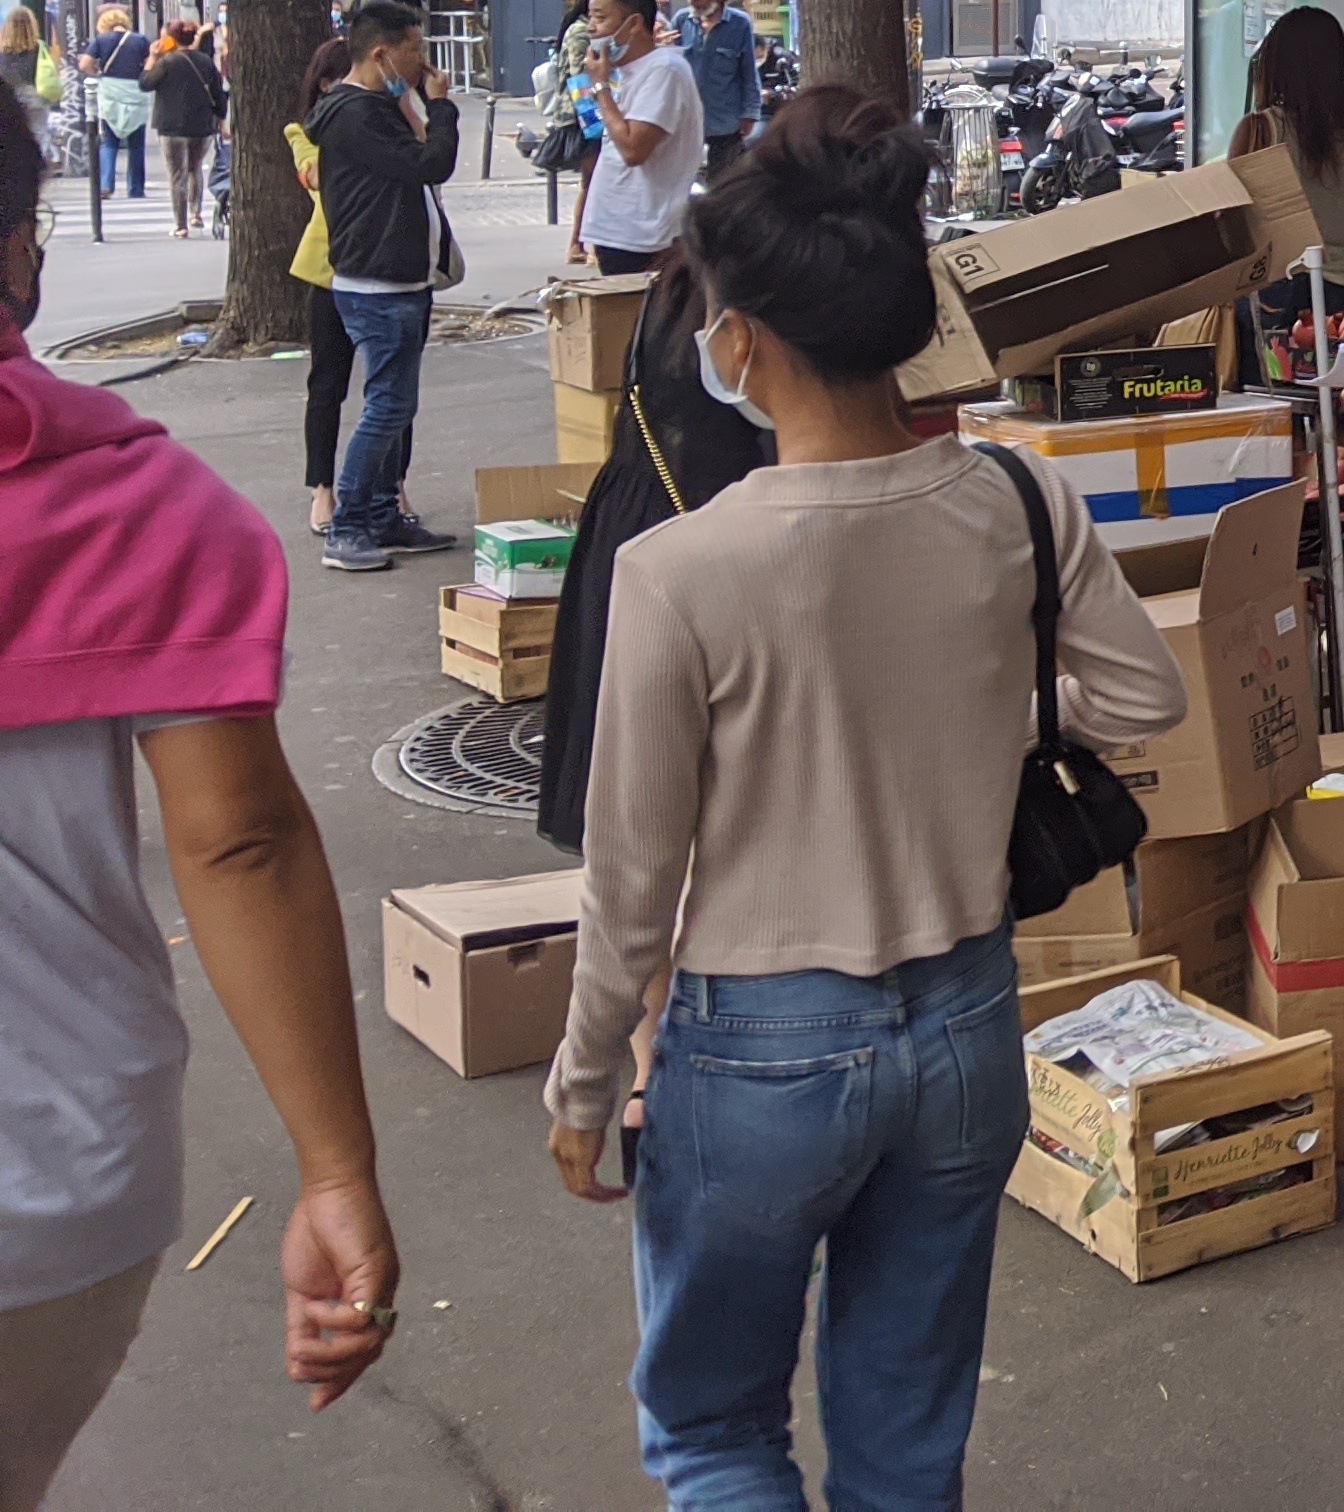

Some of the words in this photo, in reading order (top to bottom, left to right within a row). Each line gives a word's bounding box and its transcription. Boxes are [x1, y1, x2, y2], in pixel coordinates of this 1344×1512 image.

[954, 251, 985, 278] G1
[1122, 374, 1203, 400] Frutaria
[1174, 1147, 1251, 1182] Henriette
[1249, 1131, 1283, 1161] Jolly
